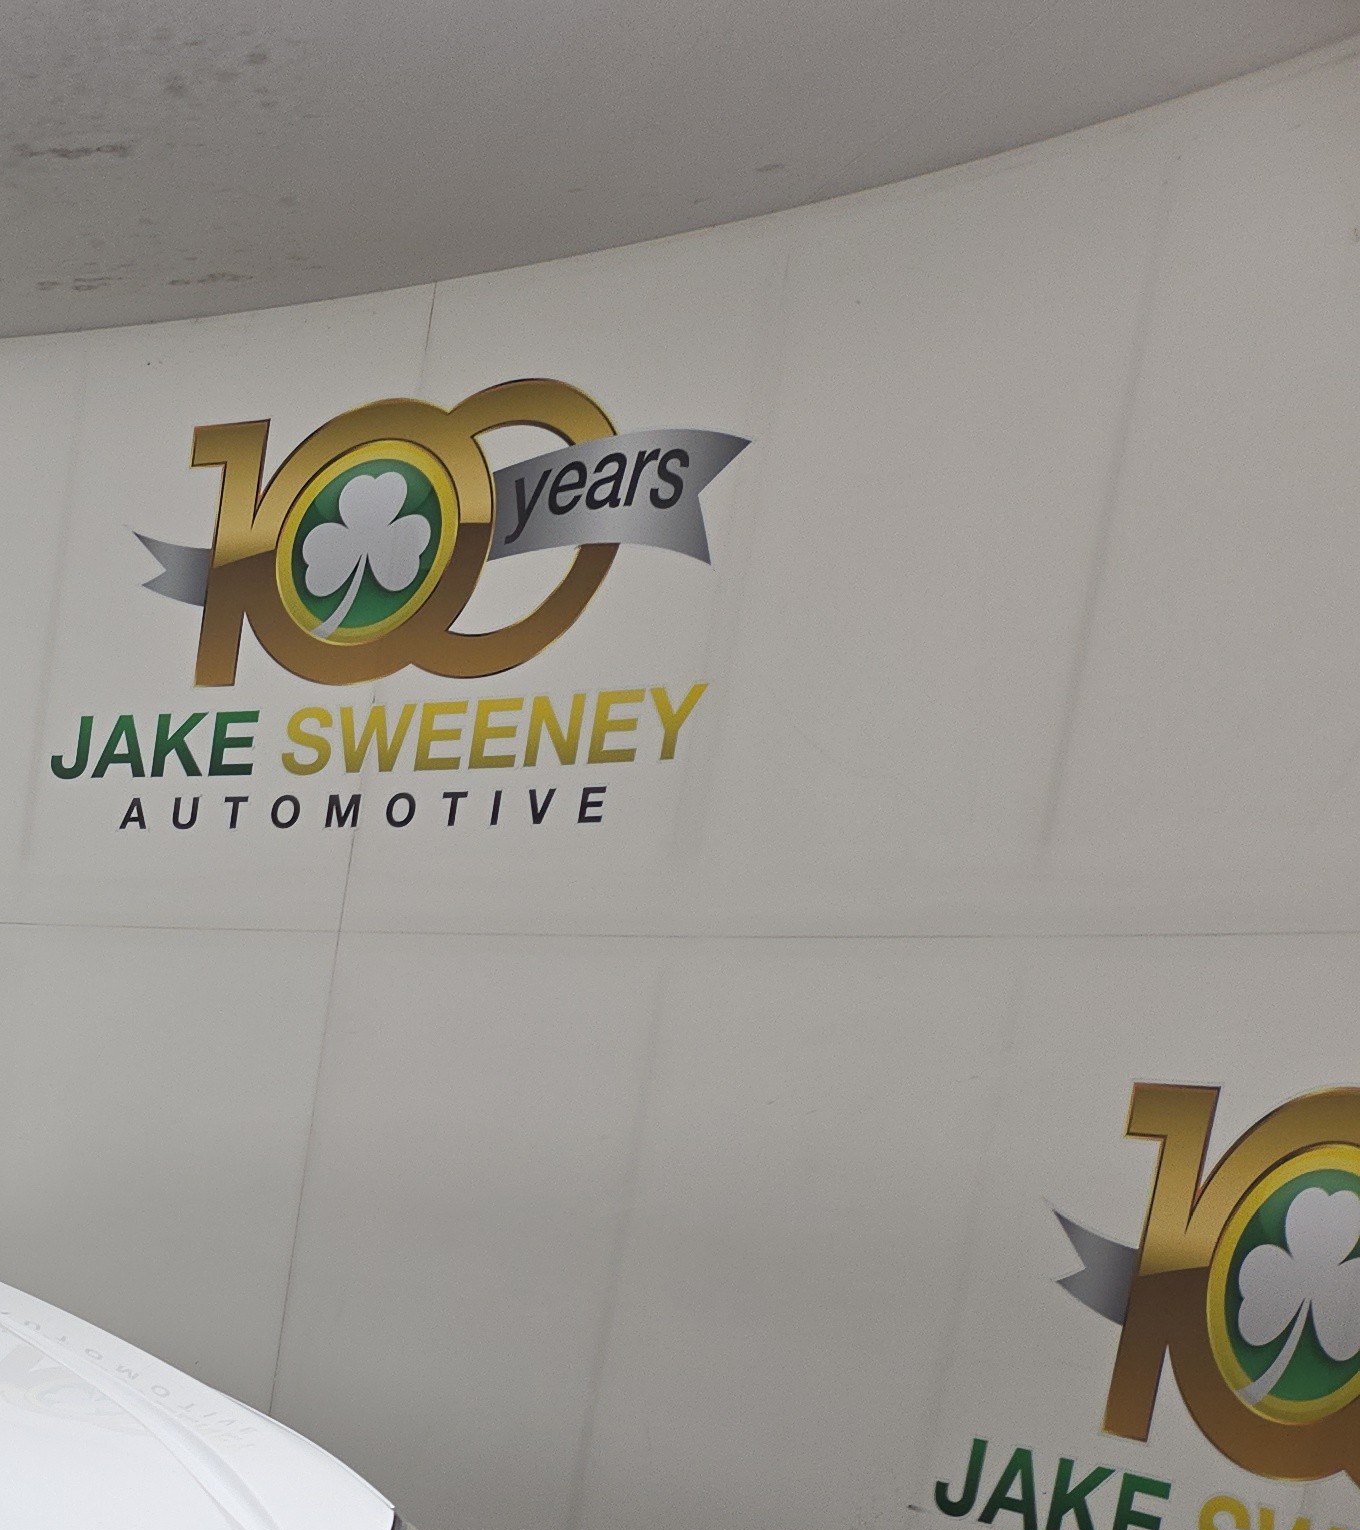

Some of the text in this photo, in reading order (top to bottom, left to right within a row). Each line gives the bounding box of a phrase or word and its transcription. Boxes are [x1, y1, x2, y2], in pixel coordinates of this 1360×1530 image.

[190, 377, 691, 688] 100 years
[50, 682, 710, 780] JAKE SWEENEY
[119, 786, 608, 831] AUTOMOTIVE
